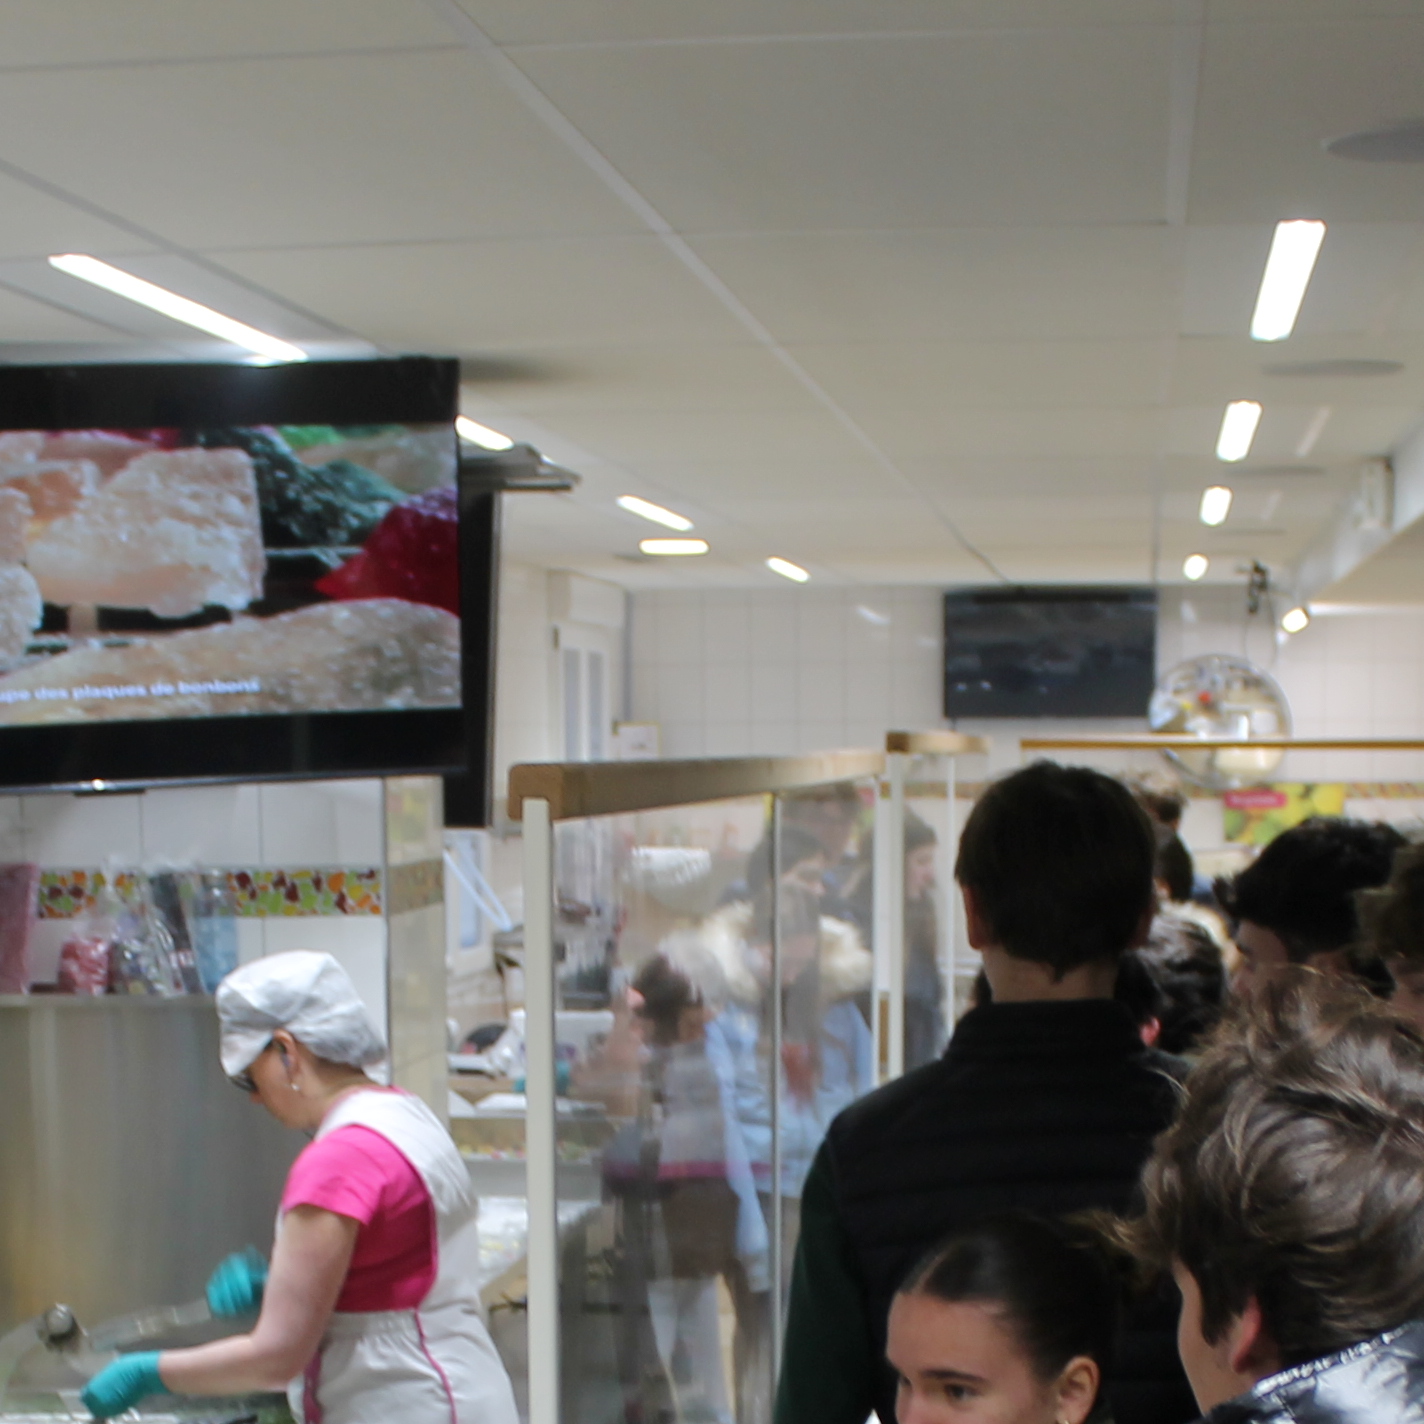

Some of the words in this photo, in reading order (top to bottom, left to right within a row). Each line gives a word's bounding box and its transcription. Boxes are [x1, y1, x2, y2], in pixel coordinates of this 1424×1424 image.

[34, 685, 69, 701] des
[72, 684, 147, 701] plaques
[150, 681, 175, 697] de
[177, 678, 261, 695] bonbons
